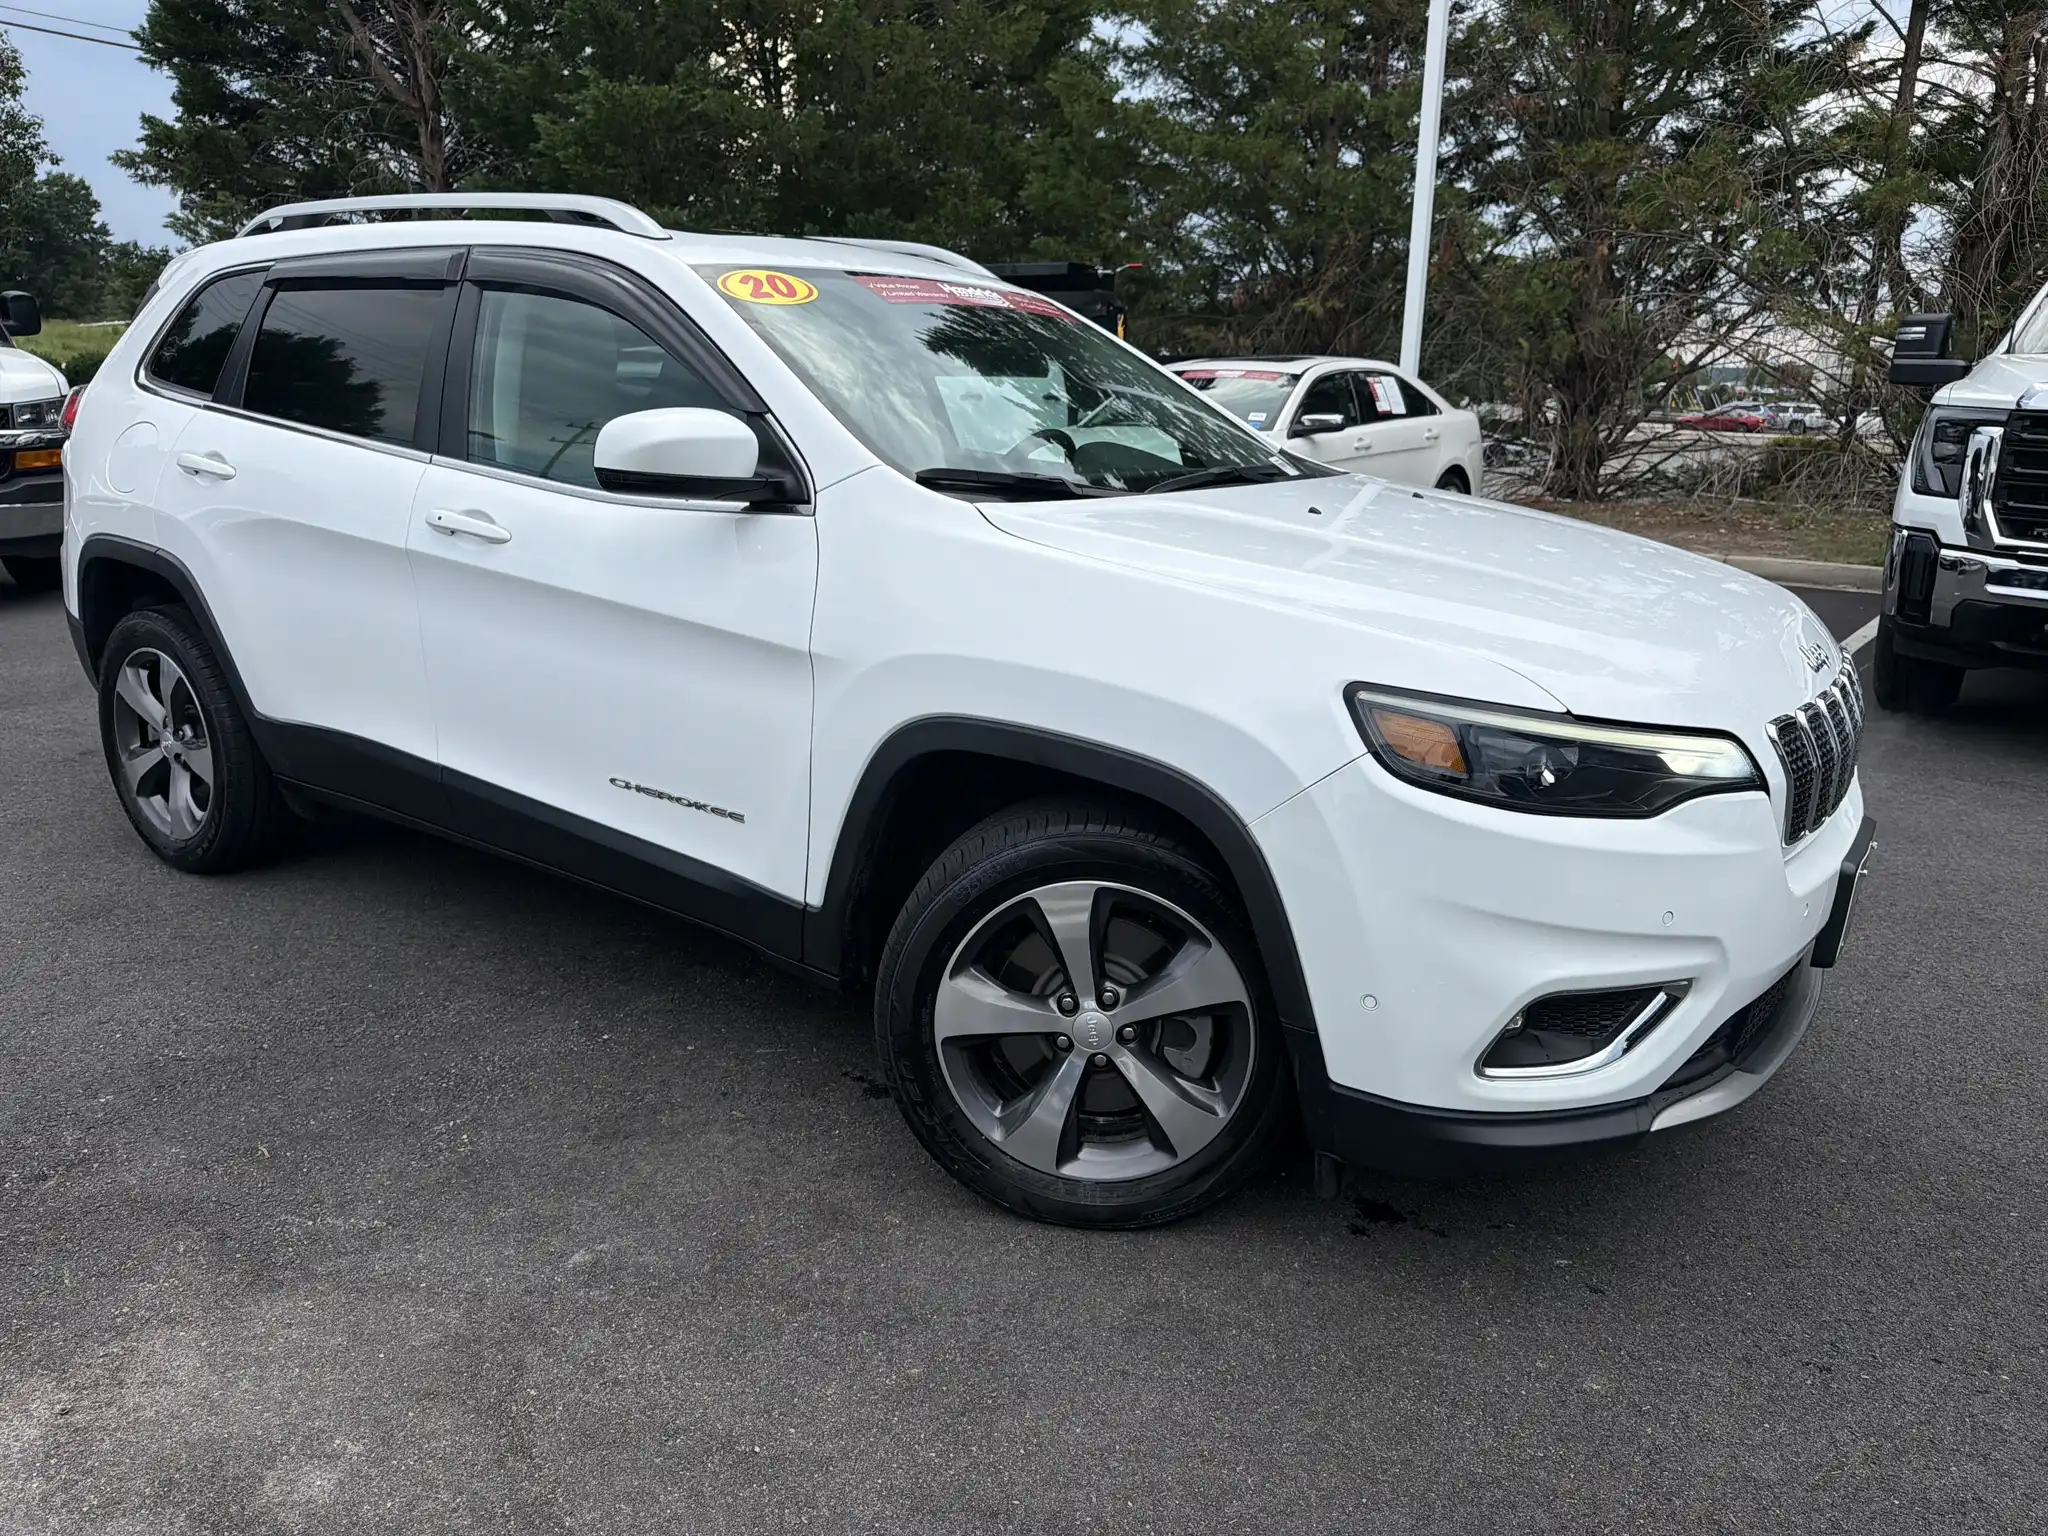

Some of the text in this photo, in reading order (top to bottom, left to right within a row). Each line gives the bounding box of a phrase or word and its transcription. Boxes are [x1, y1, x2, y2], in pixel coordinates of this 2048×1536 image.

[739, 274, 797, 299] 20
[608, 777, 746, 824] CHEROKEE
[1086, 1015, 1099, 1046] Jeep
